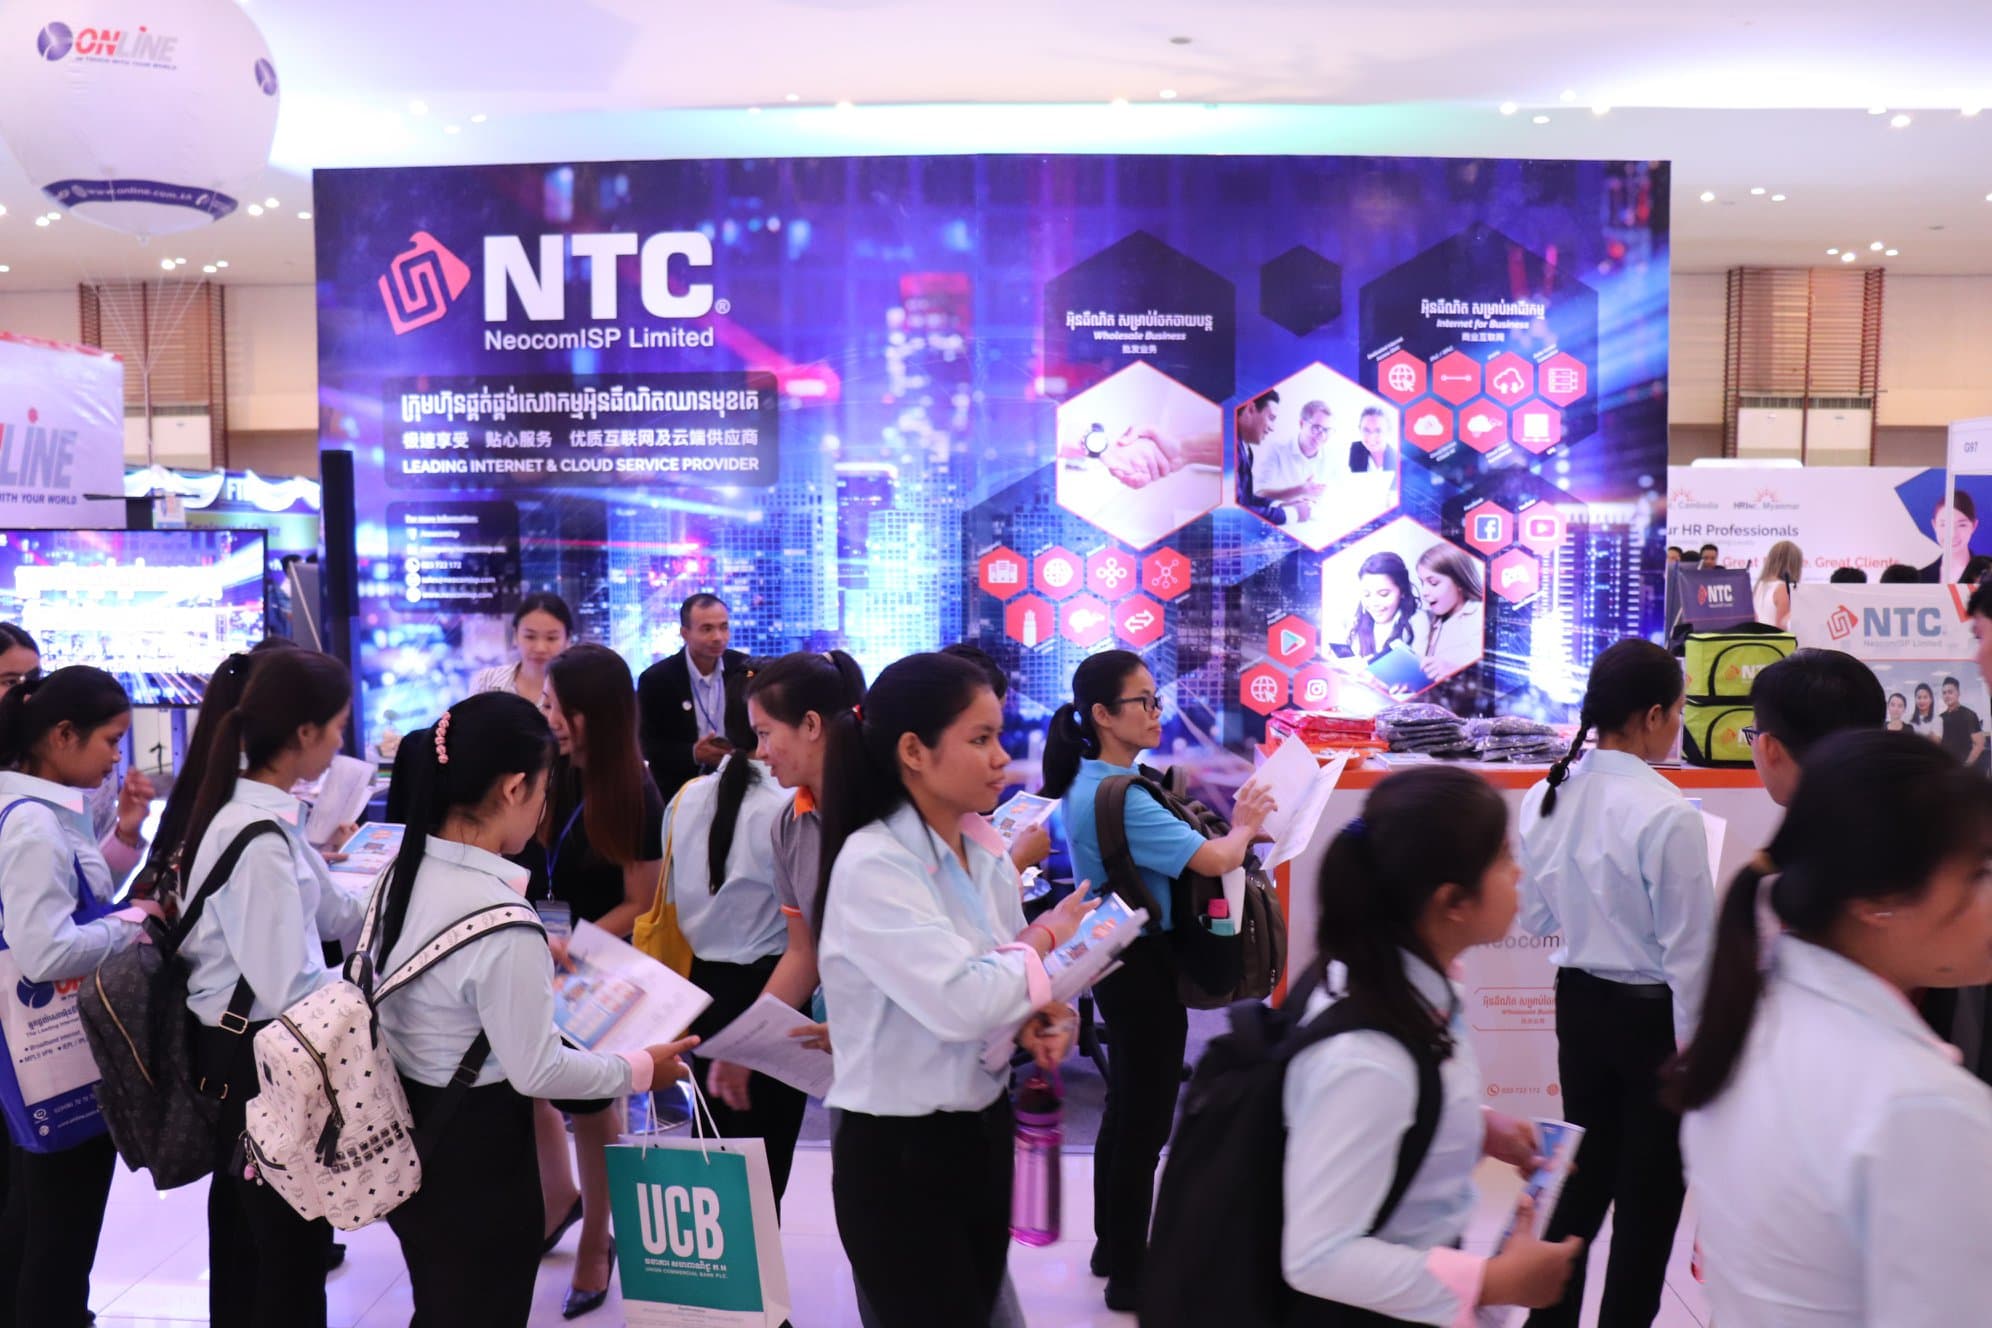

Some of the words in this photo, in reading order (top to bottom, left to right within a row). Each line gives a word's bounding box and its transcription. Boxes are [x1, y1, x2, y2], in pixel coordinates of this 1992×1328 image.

[484, 231, 714, 322] NTC
[484, 328, 621, 350] NeocomISP
[629, 327, 715, 348] Limited
[403, 460, 467, 474] LEADING
[470, 459, 543, 473] INTERNET
[546, 459, 557, 472] &
[561, 458, 613, 472] CLOUD
[616, 458, 679, 472] SERVICE
[682, 457, 760, 471] PROVIDER
[1682, 525, 1702, 536] HR
[1706, 524, 1800, 537] Professionals
[1707, 584, 1733, 603] NTC
[1863, 607, 1942, 638] NTC
[636, 1182, 725, 1260] UCB
